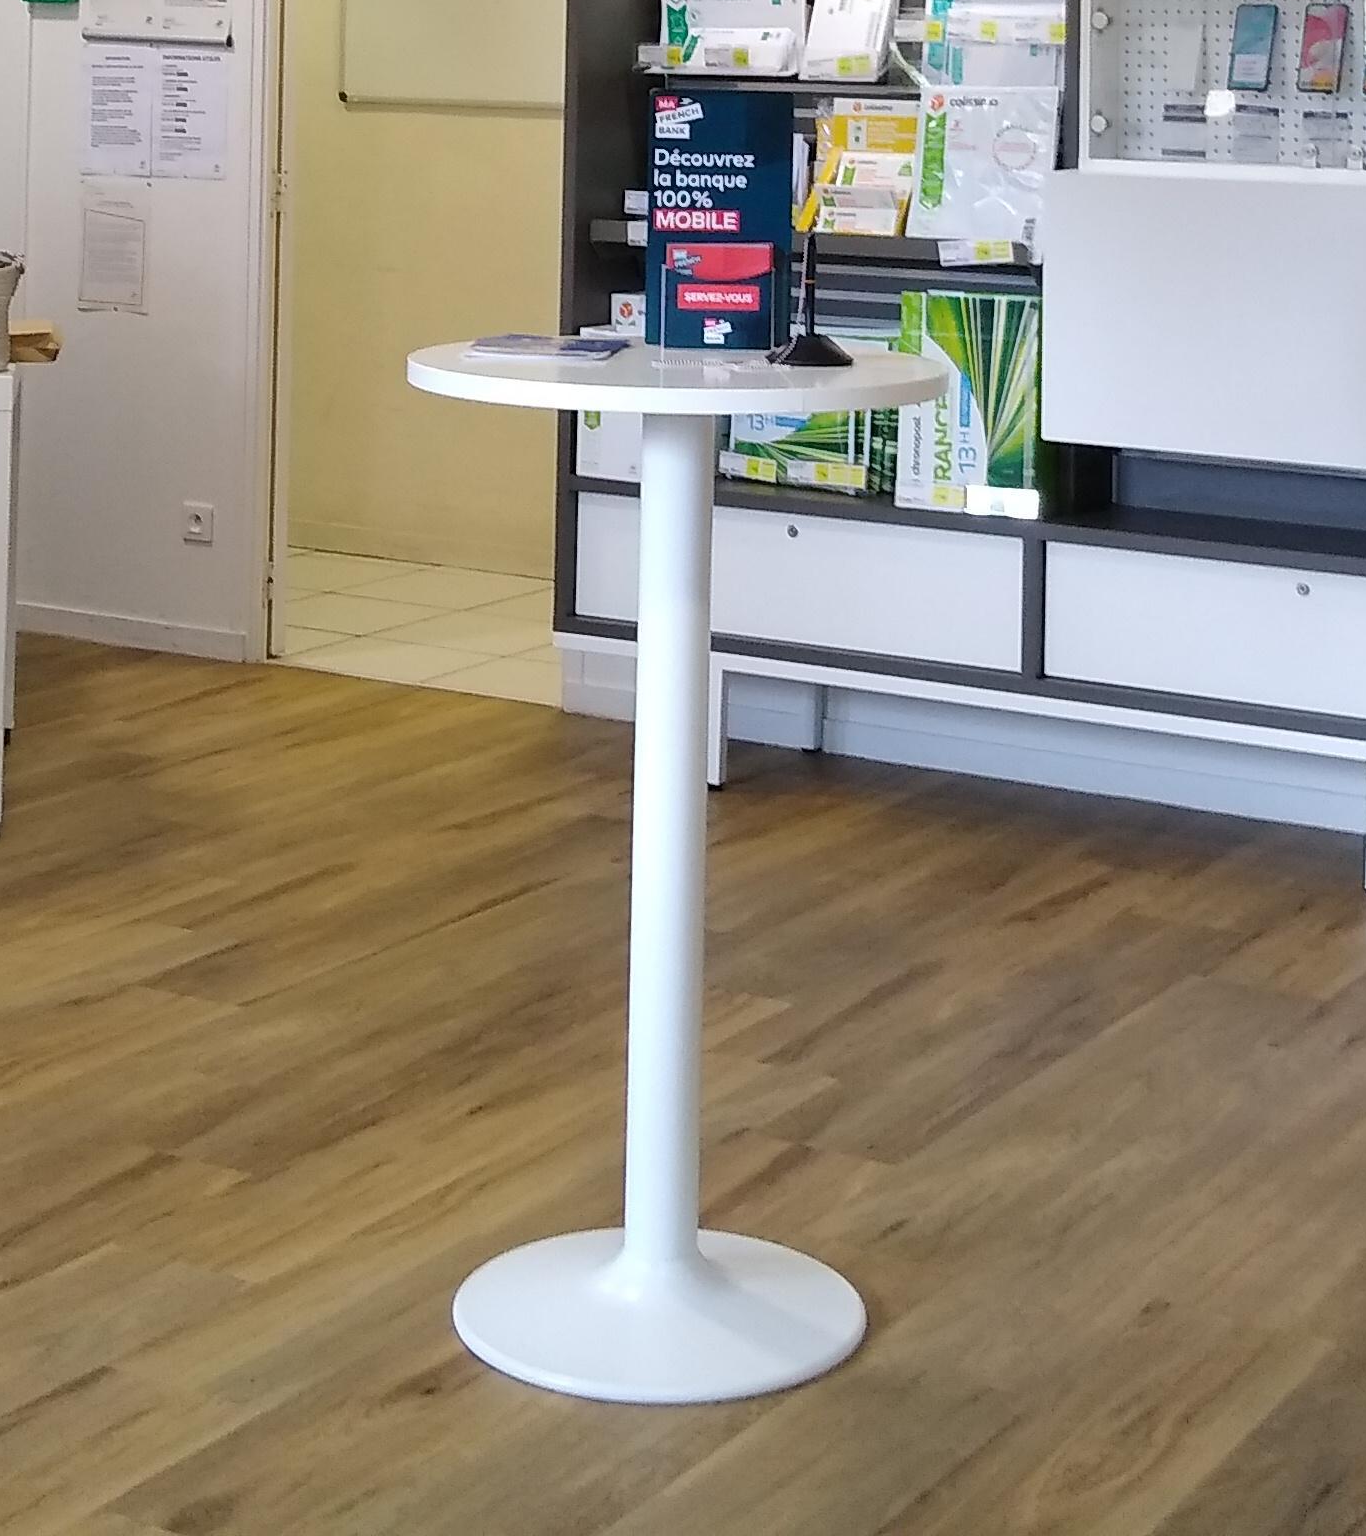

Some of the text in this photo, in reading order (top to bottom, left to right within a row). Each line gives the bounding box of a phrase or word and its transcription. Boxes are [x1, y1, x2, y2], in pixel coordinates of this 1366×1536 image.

[658, 99, 676, 109] MA
[659, 107, 700, 124] FRENCH
[658, 126, 686, 134] BANK
[654, 148, 755, 168] Découvrez
[653, 168, 748, 192] la banque
[653, 190, 714, 208] 100%
[655, 209, 739, 230] MOBILE
[683, 291, 754, 304] SERVEZ-VOUS
